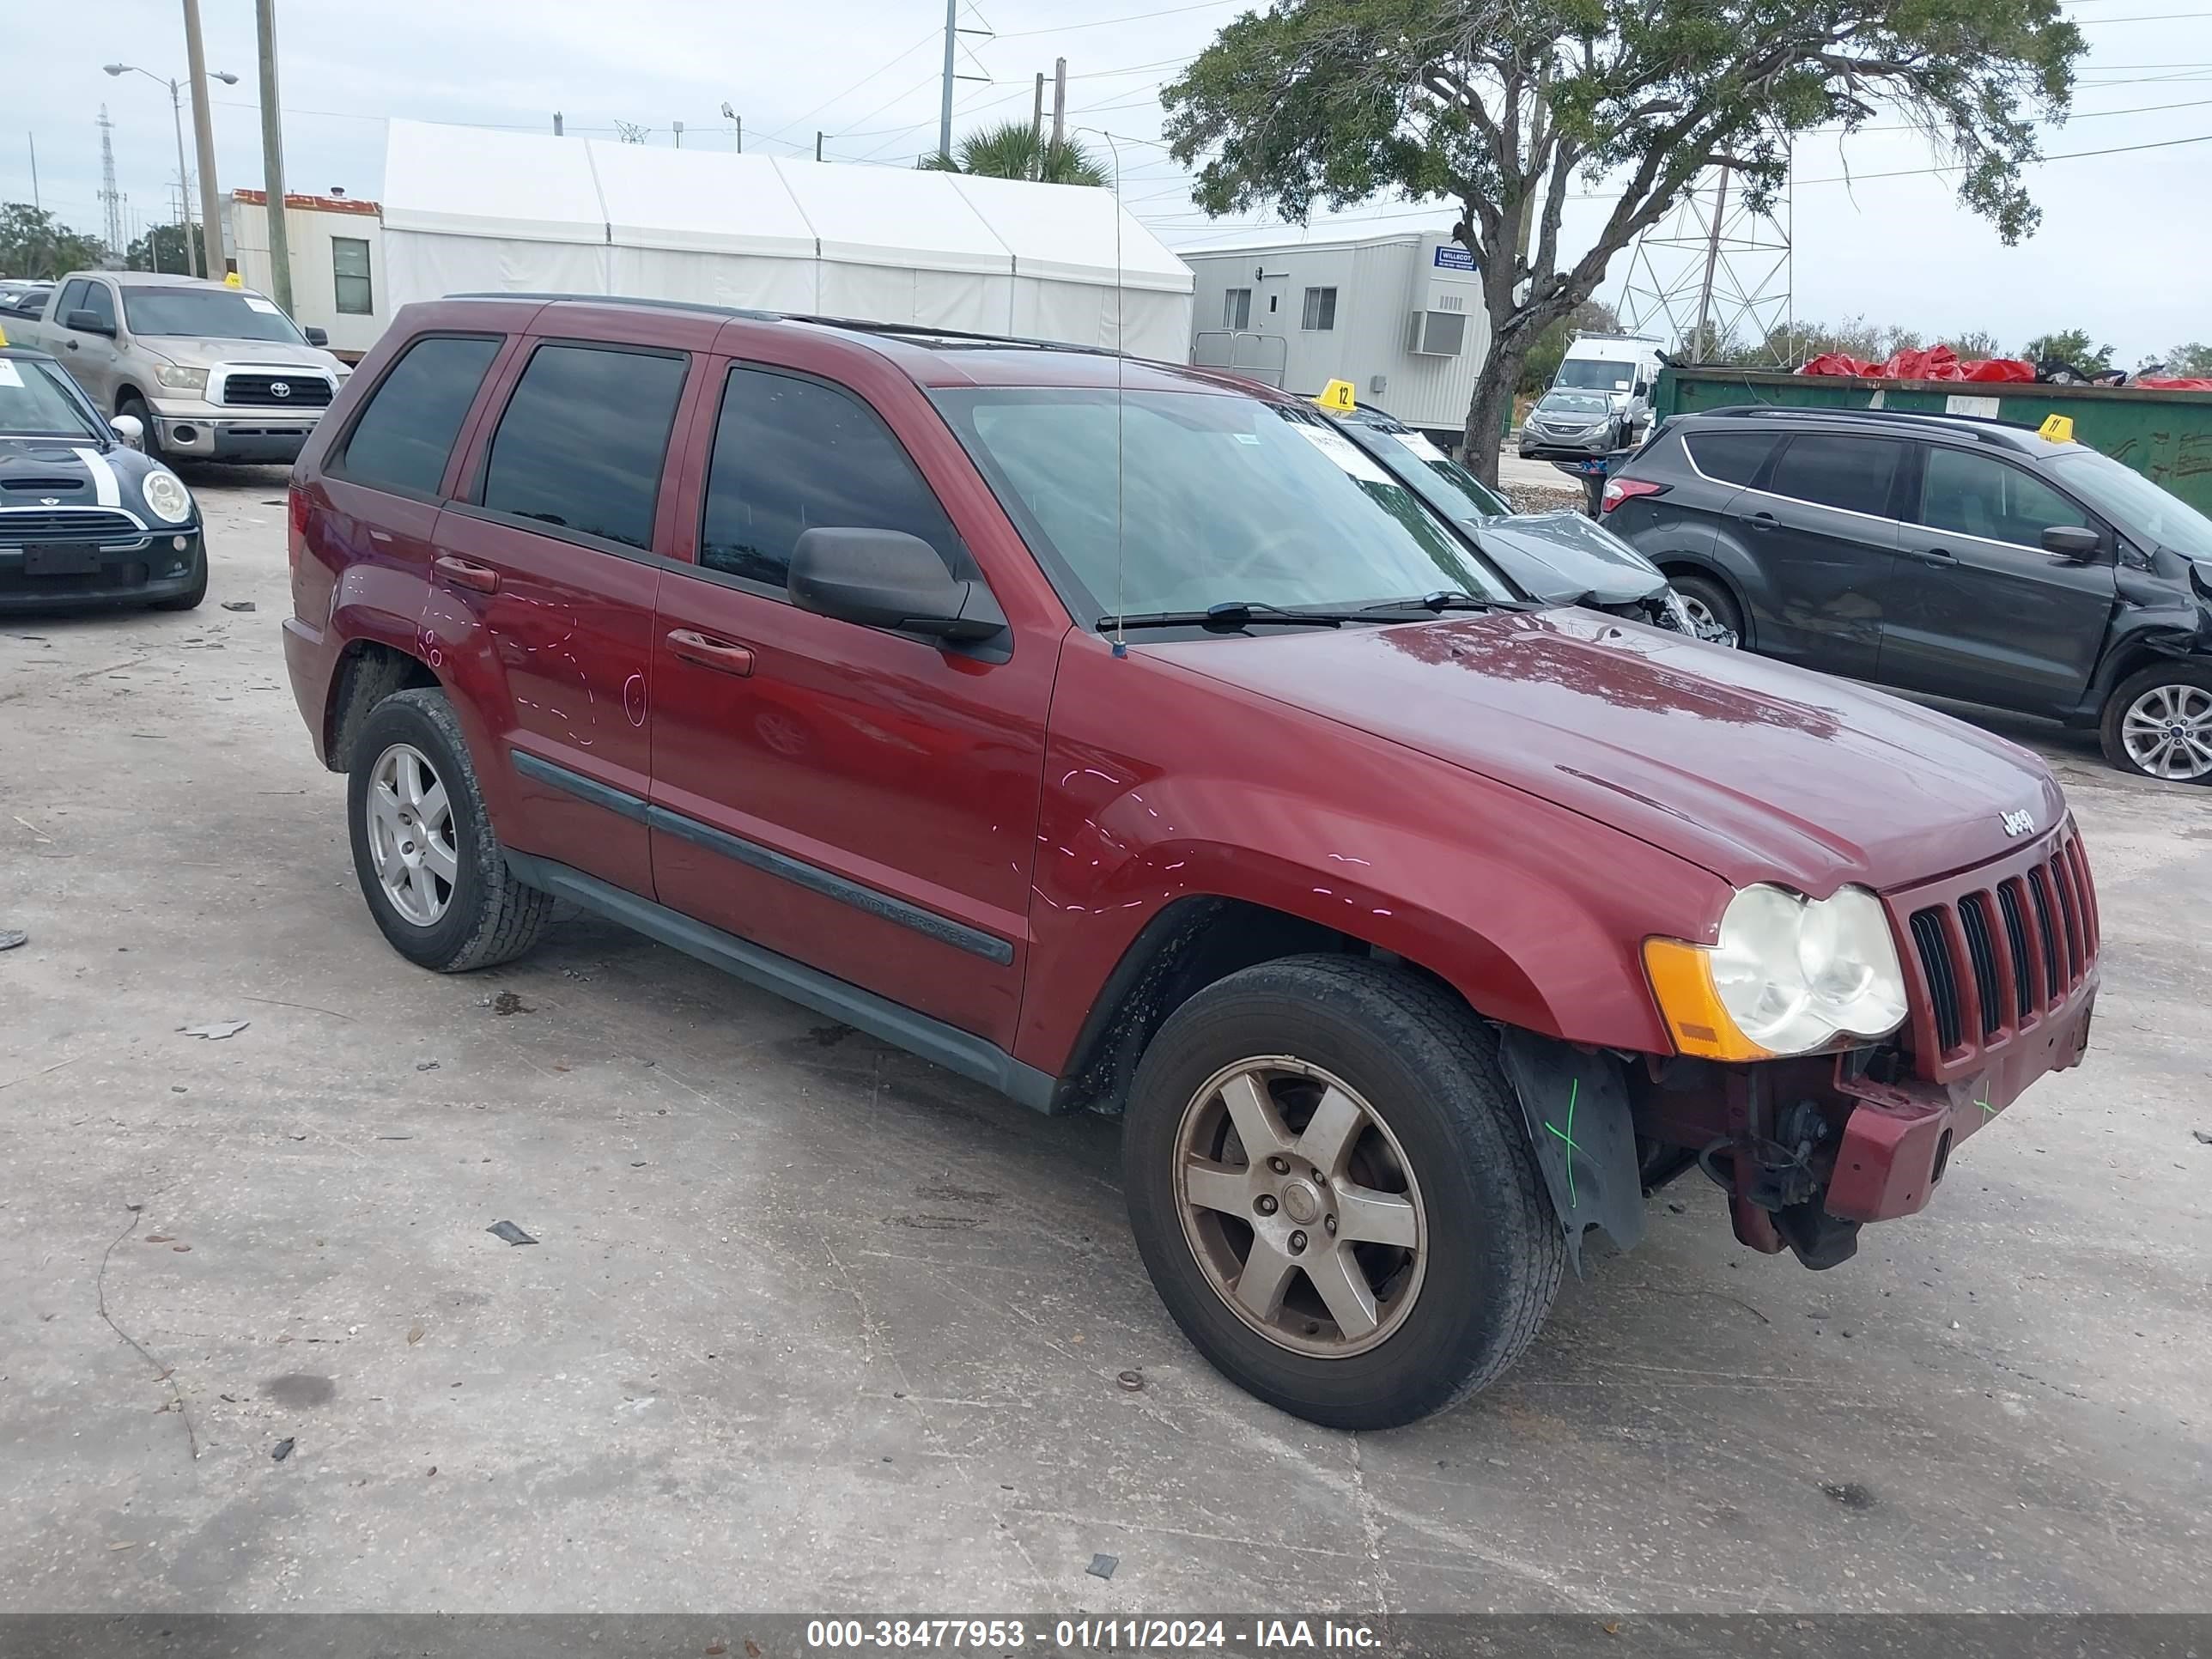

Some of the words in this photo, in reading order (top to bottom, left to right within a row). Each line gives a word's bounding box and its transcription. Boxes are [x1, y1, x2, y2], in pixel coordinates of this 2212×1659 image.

[1443, 252, 1472, 261] WILLSCOT
[1340, 386, 1348, 404] 12
[2048, 418, 2062, 433] 11
[1999, 809, 2034, 836] Jeep
[884, 902, 970, 944] CHEROKEE
